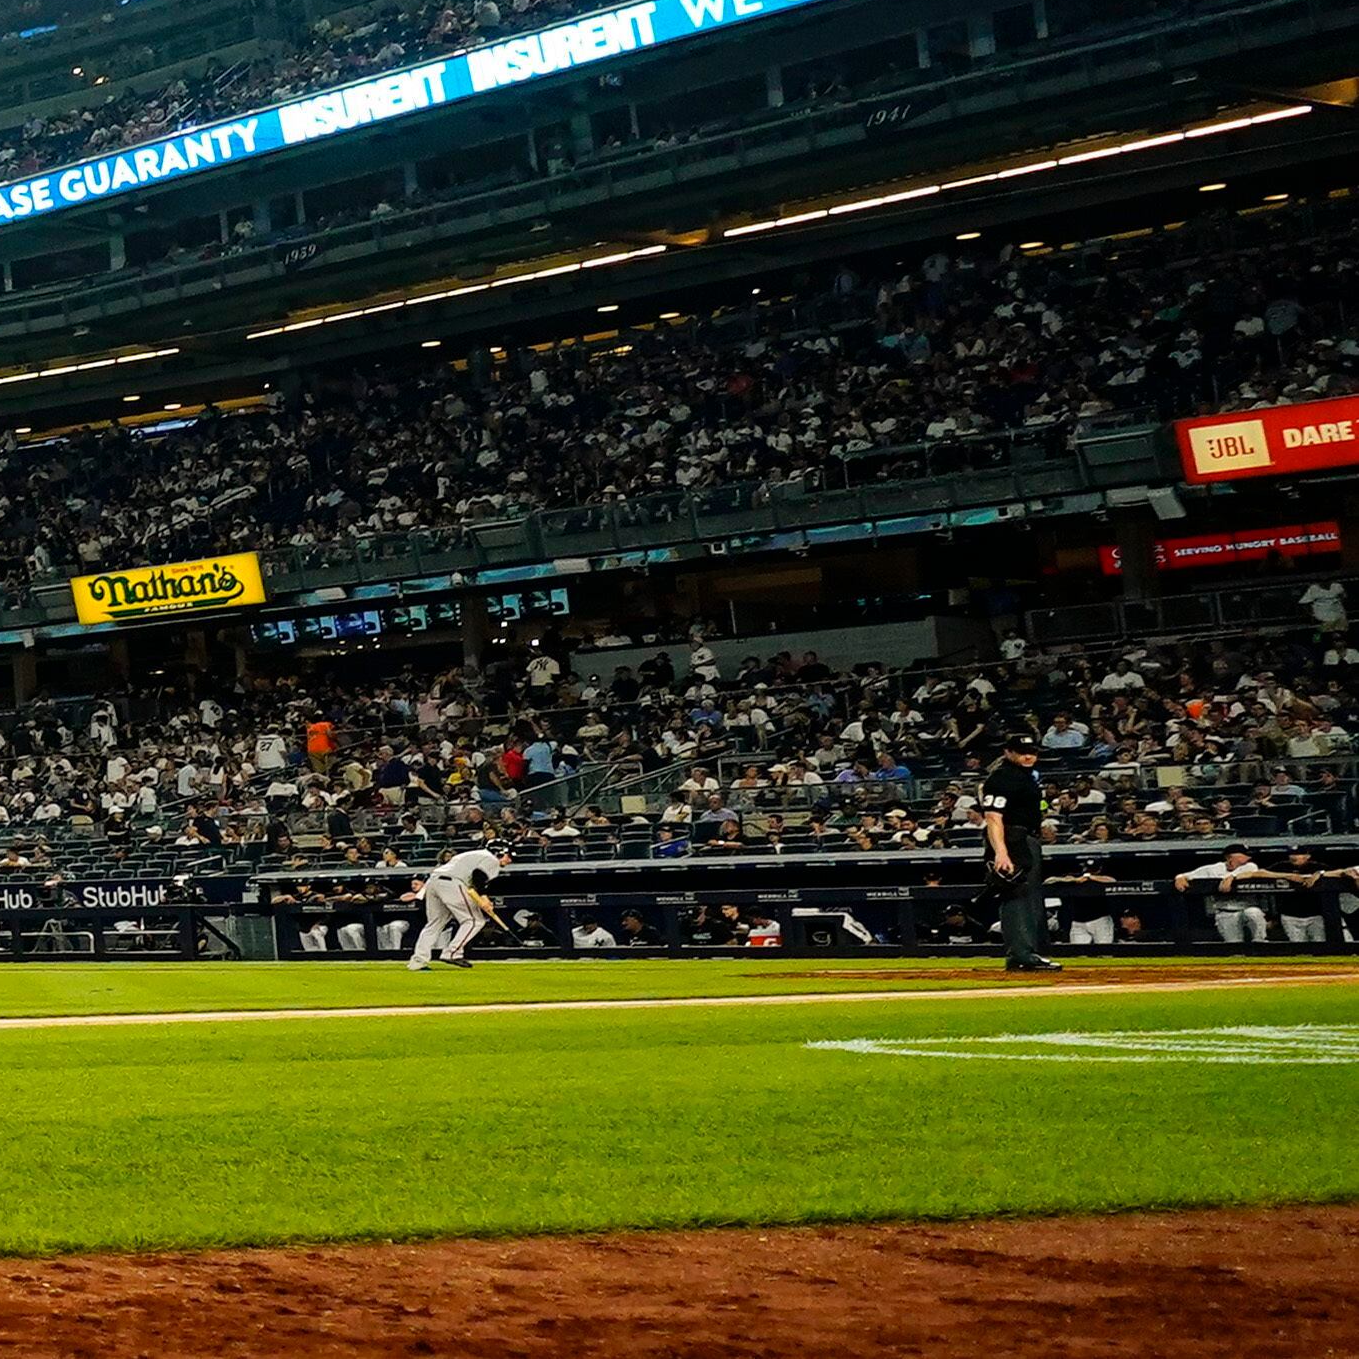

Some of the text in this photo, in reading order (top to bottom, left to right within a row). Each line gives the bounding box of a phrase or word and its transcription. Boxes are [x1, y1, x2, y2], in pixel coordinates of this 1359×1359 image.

[59, 118, 258, 201] GUARANTY
[278, 64, 448, 143] INSURENT
[468, 3, 660, 93] INSURENT
[865, 104, 912, 128] 1941
[1207, 436, 1255, 458] JBL
[1283, 421, 1355, 448] DARE
[1280, 533, 1338, 545] BASEBALL
[89, 563, 244, 607] Nathan's
